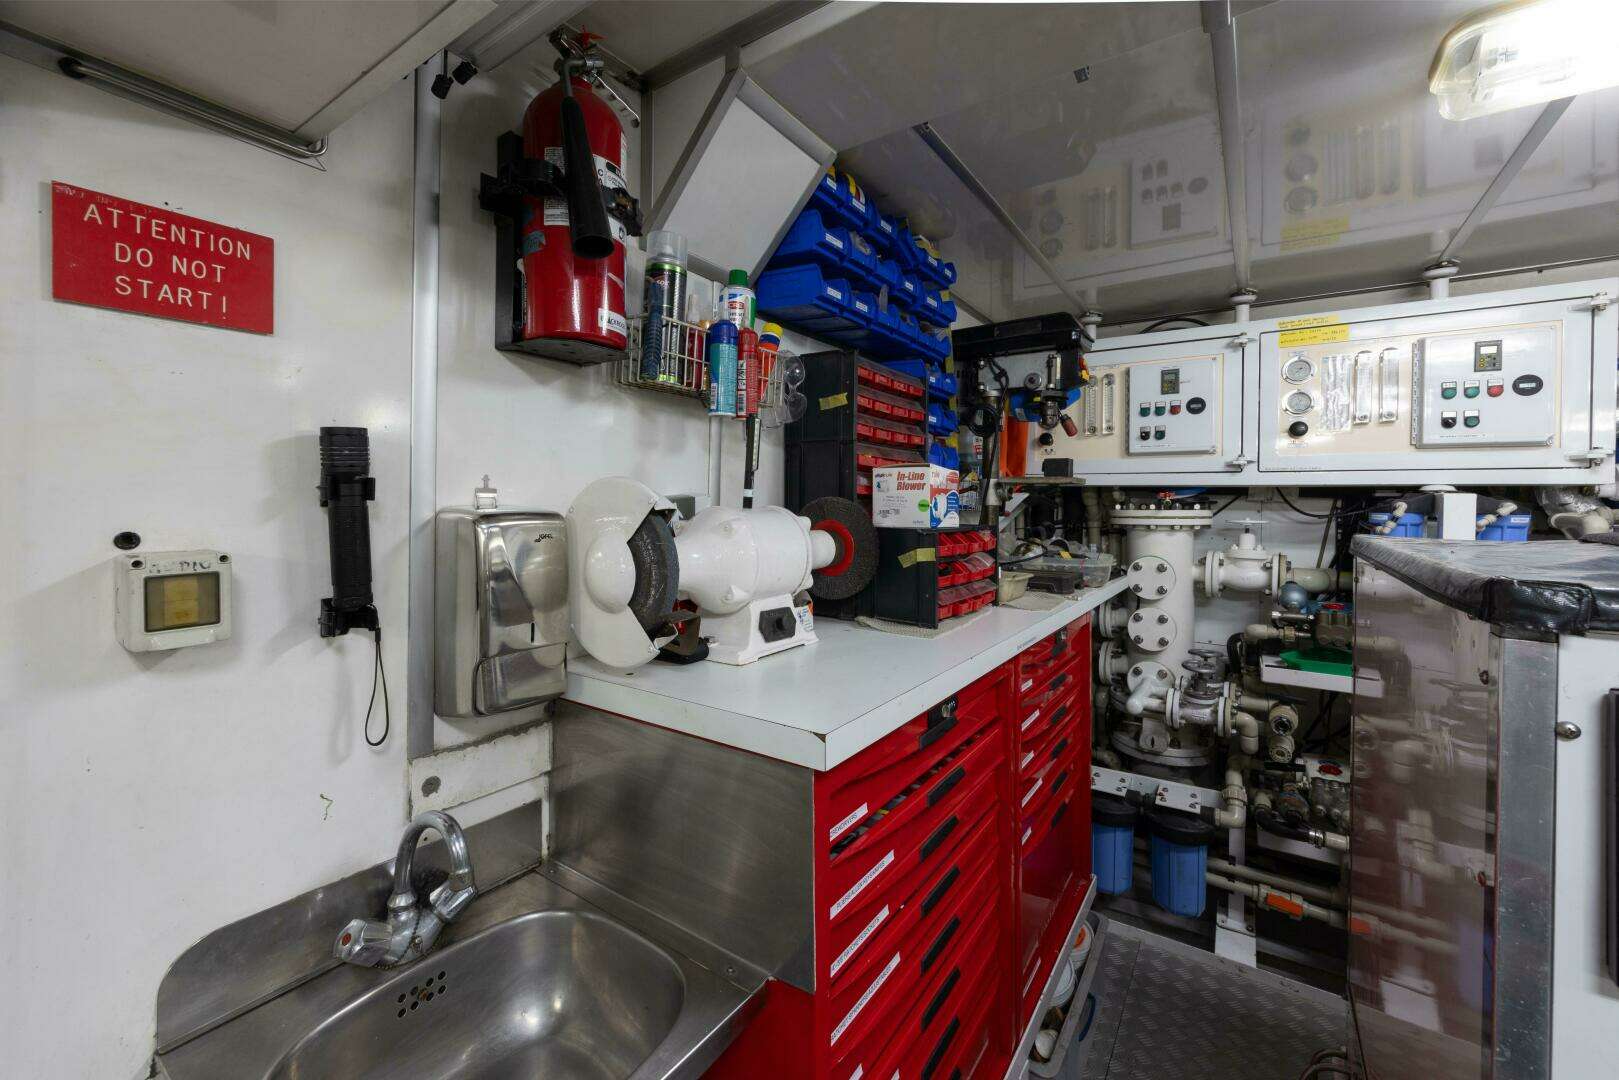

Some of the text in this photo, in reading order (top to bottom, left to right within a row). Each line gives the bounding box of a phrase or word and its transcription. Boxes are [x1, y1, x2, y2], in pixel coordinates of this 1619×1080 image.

[83, 203, 251, 260] ATTENTION
[115, 242, 226, 283] DO NOT
[896, 471, 926, 481] In-Line
[896, 481, 927, 491] Blower
